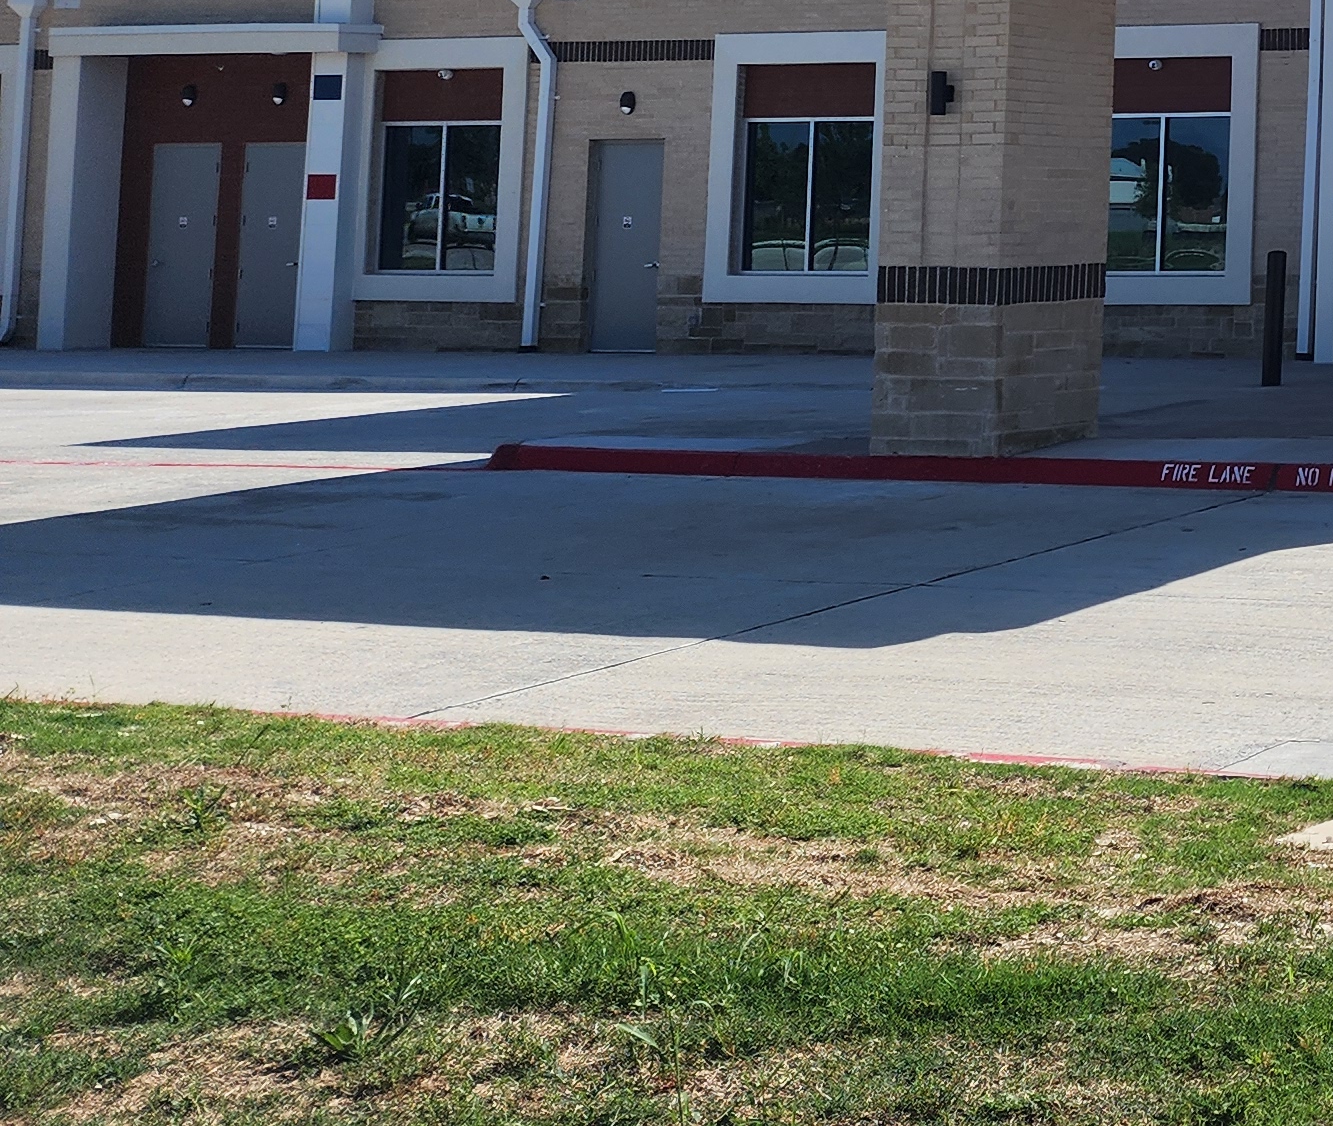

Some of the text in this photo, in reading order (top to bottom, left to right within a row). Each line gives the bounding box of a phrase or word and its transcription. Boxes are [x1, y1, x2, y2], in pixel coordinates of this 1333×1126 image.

[1160, 463, 1202, 482] FIRE
[1208, 464, 1256, 484] LANE
[1295, 467, 1320, 487] NO
